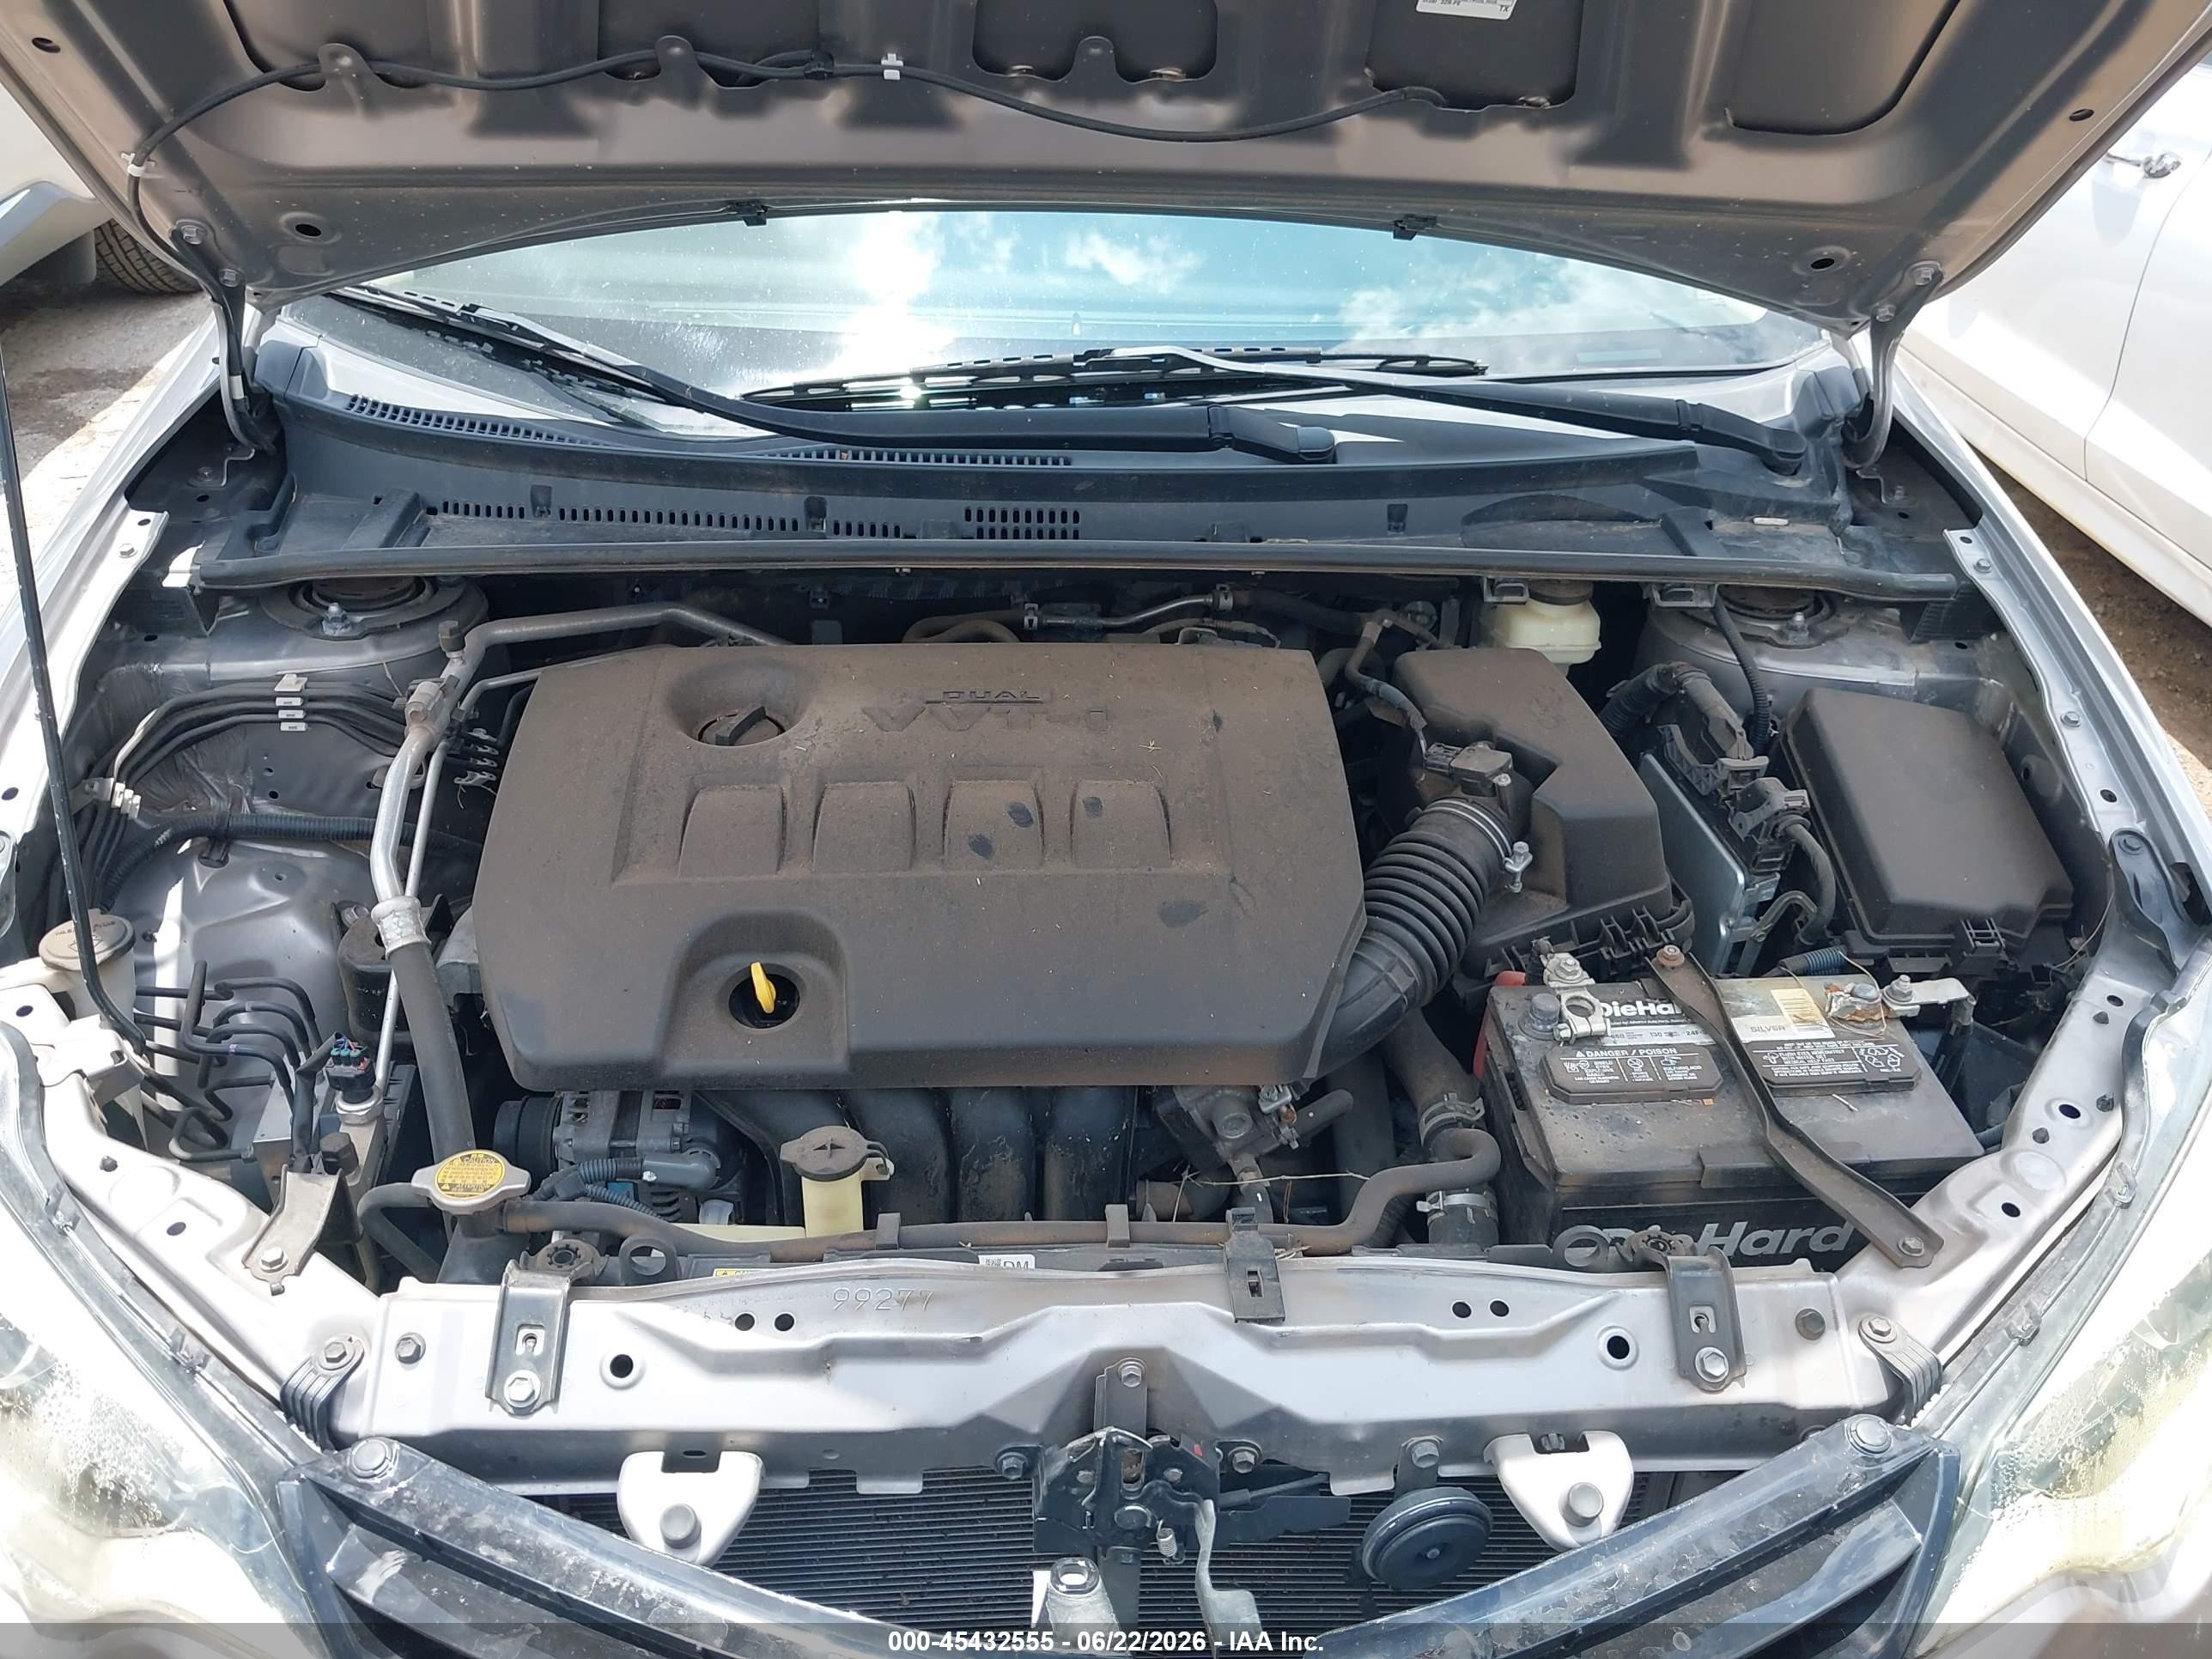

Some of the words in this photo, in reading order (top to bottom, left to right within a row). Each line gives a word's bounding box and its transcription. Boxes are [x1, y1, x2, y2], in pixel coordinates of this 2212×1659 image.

[942, 690, 1041, 700] DUAL
[1750, 1024, 1786, 1033] SILVER
[1602, 1220, 1856, 1259] Hard
[833, 1287, 934, 1311] 99277
